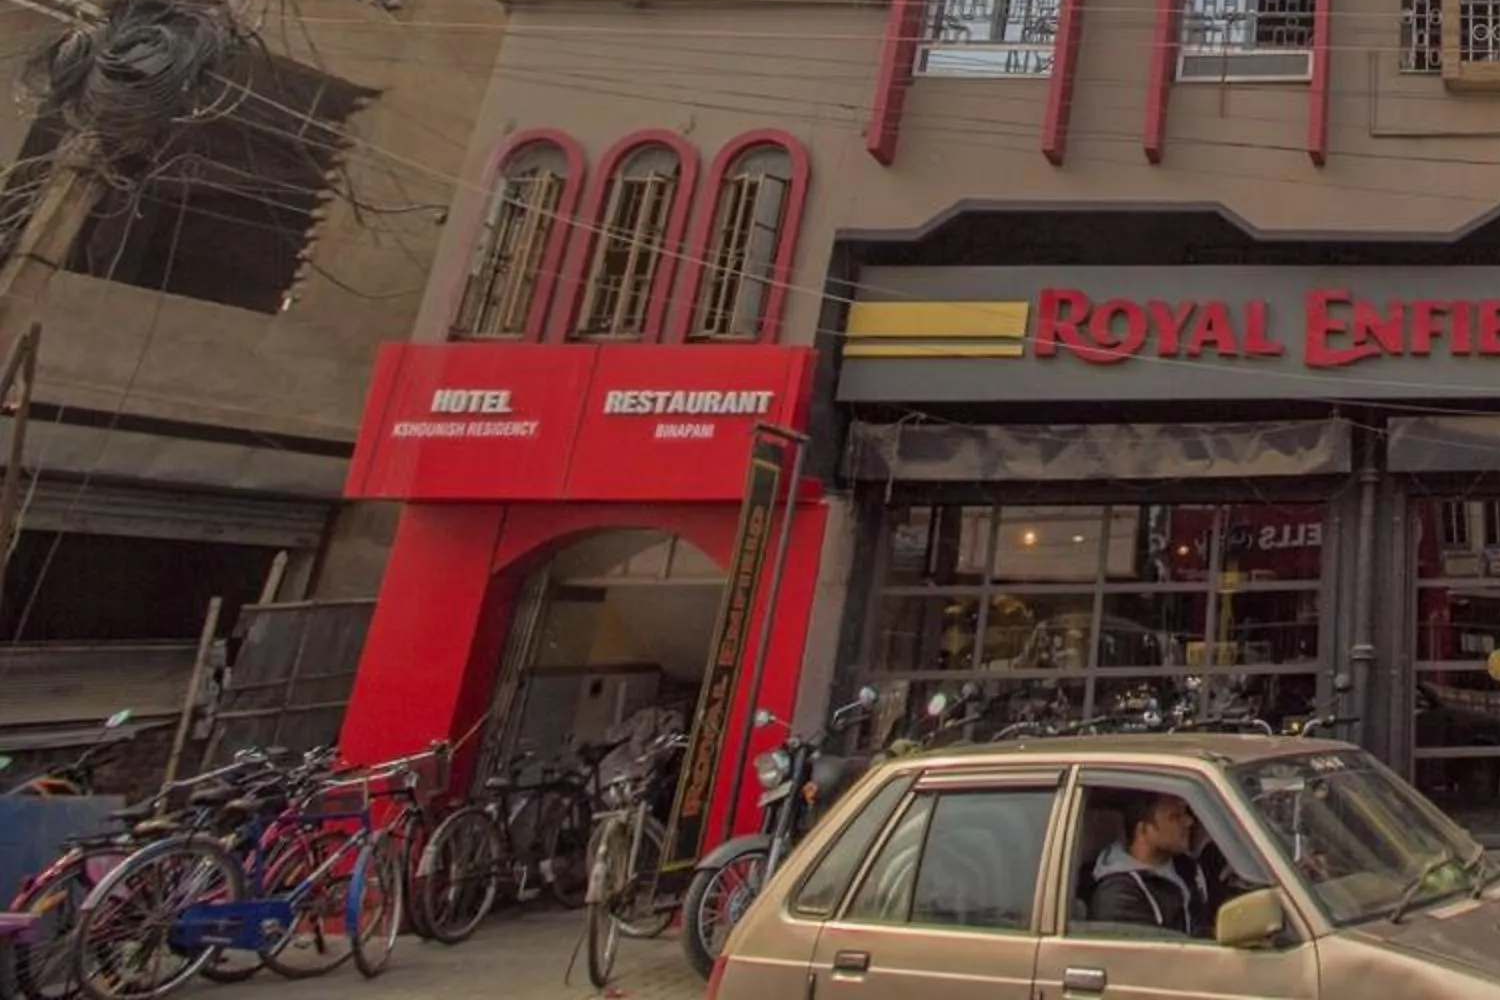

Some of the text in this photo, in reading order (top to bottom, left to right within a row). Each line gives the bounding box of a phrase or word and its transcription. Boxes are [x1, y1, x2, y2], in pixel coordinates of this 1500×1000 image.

[1034, 288, 1287, 365] ROYAL
[431, 389, 513, 413] HOTEL
[604, 390, 775, 414] RESTAURANT
[466, 419, 539, 437] RESIDENCY
